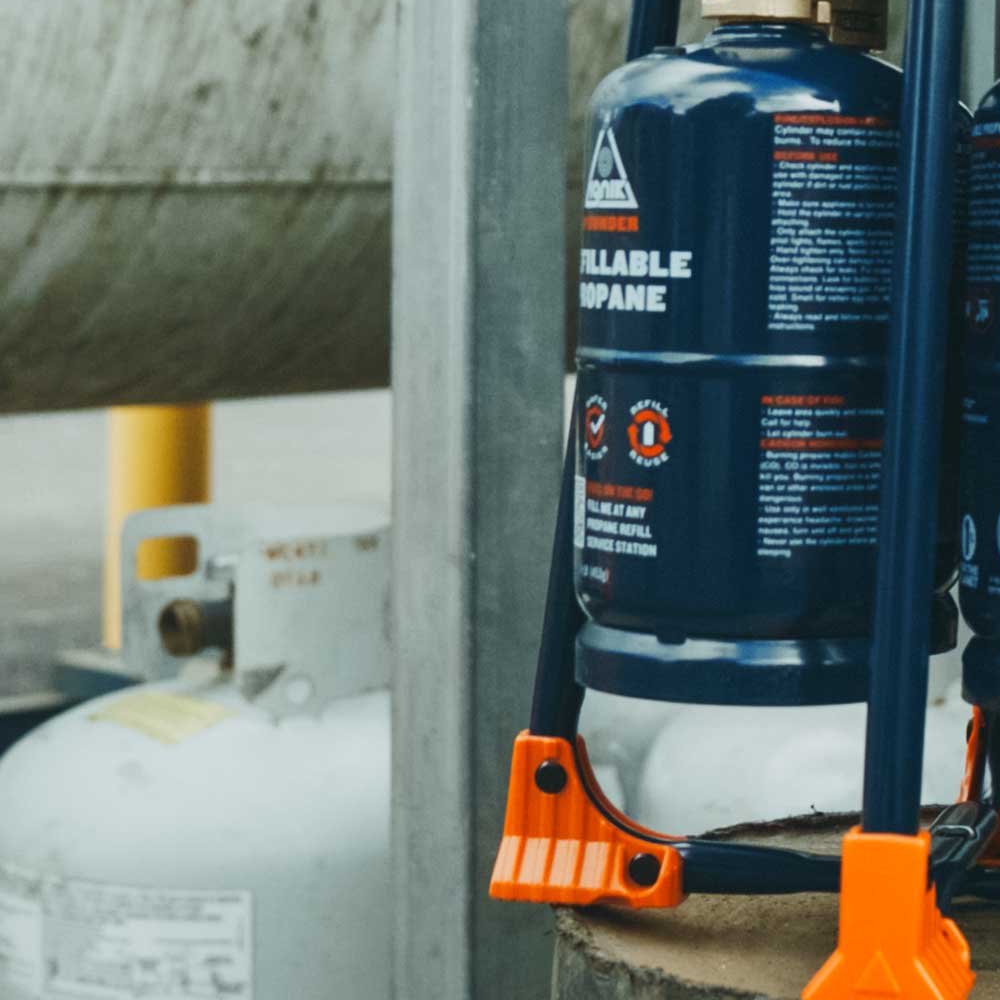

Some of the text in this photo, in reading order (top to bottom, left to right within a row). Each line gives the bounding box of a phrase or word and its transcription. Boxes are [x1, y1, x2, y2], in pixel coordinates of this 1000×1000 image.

[629, 399, 669, 418] REFILL
[629, 449, 669, 467] REUSE
[613, 504, 625, 517] AT
[625, 505, 646, 519] ANY
[619, 523, 652, 539] REFILL
[615, 540, 657, 557] STATION
